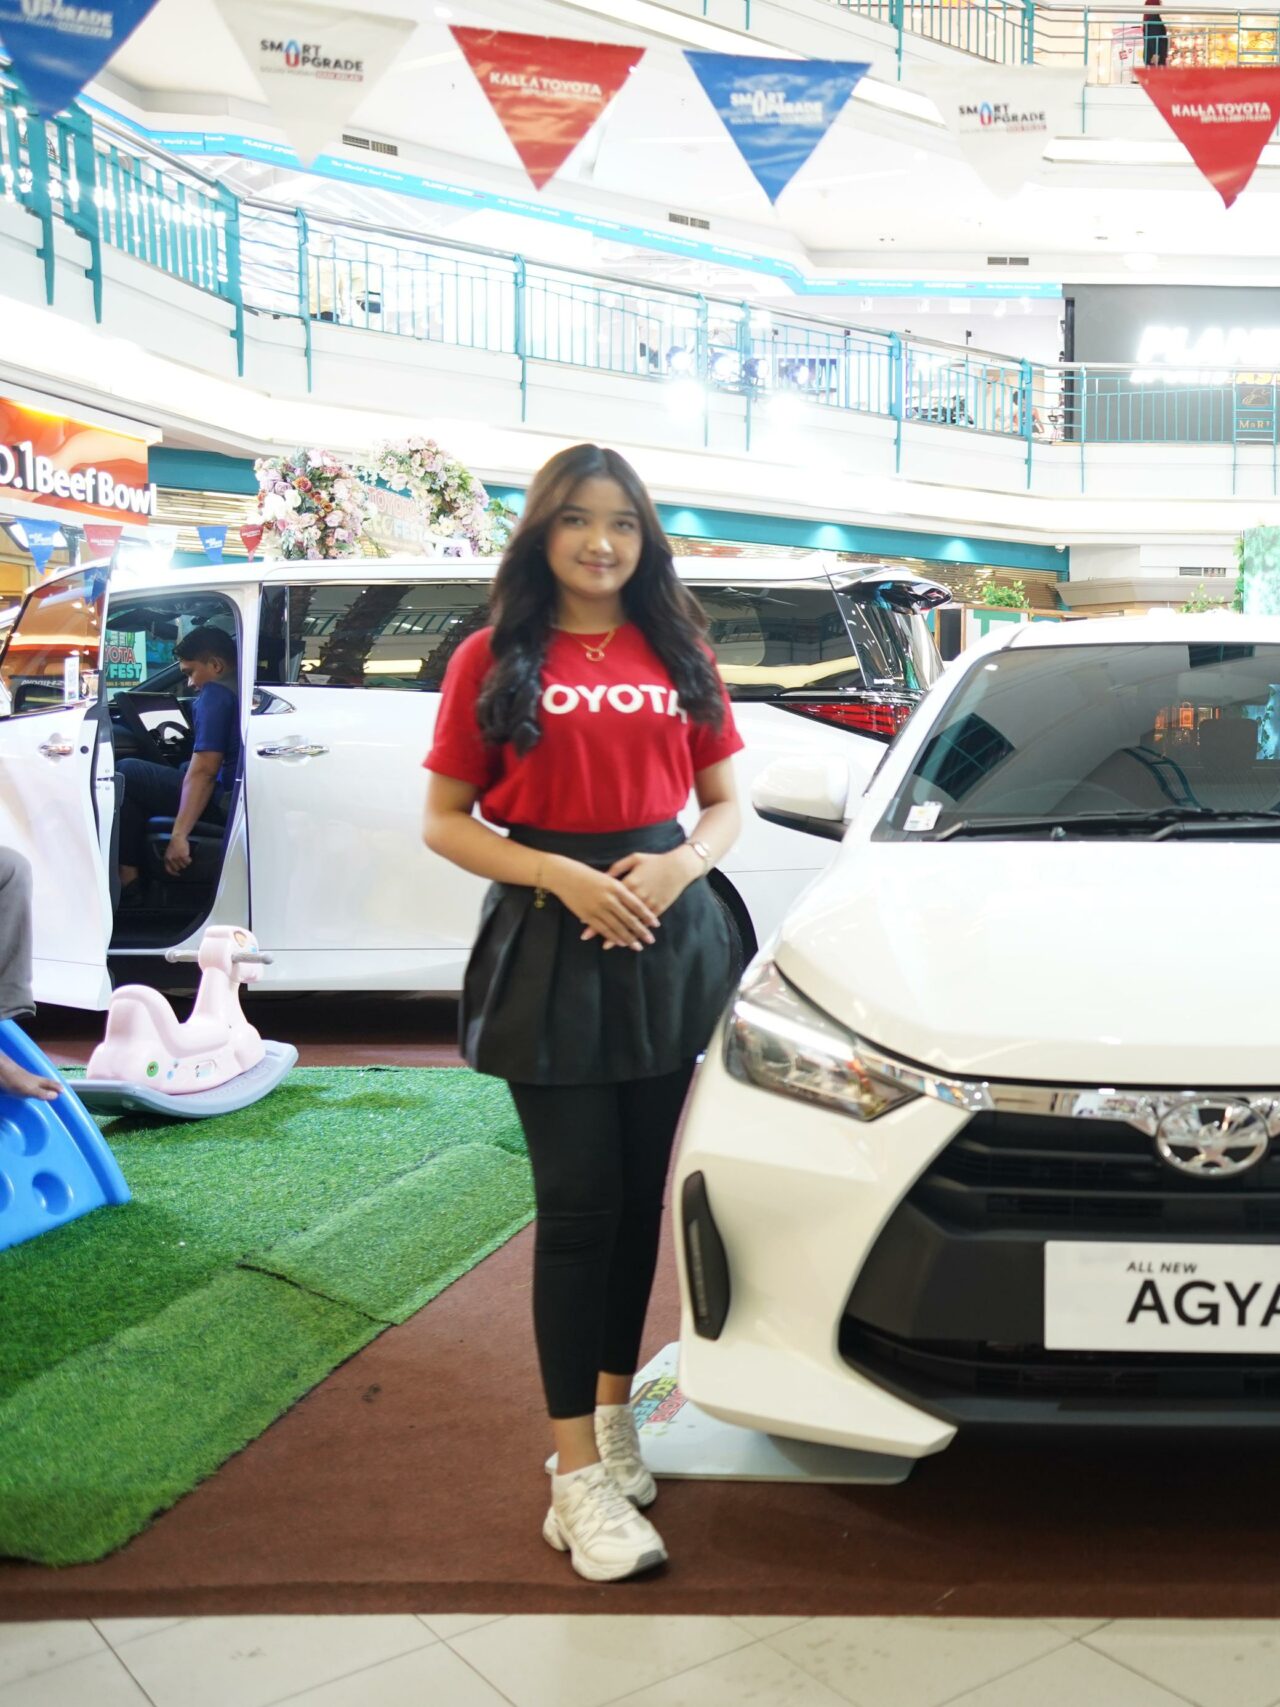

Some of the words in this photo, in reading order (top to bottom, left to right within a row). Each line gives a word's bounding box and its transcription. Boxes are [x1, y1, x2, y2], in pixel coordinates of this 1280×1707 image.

[260, 39, 321, 56] SMART
[285, 53, 363, 71] UPGRADE
[489, 72, 539, 89] KALLA
[540, 77, 602, 96] TOYOTA
[959, 101, 1009, 114] SMART
[1172, 104, 1216, 117] KALLA
[1216, 102, 1271, 115] TOYOTA
[980, 112, 1046, 126] UPGRADE
[35, 455, 96, 503] Beef
[97, 471, 157, 515] Bowl
[110, 663, 142, 679] FEST
[542, 683, 688, 725] OYOTA
[1126, 1261, 1154, 1274] ALL
[1160, 1262, 1199, 1275] NEW
